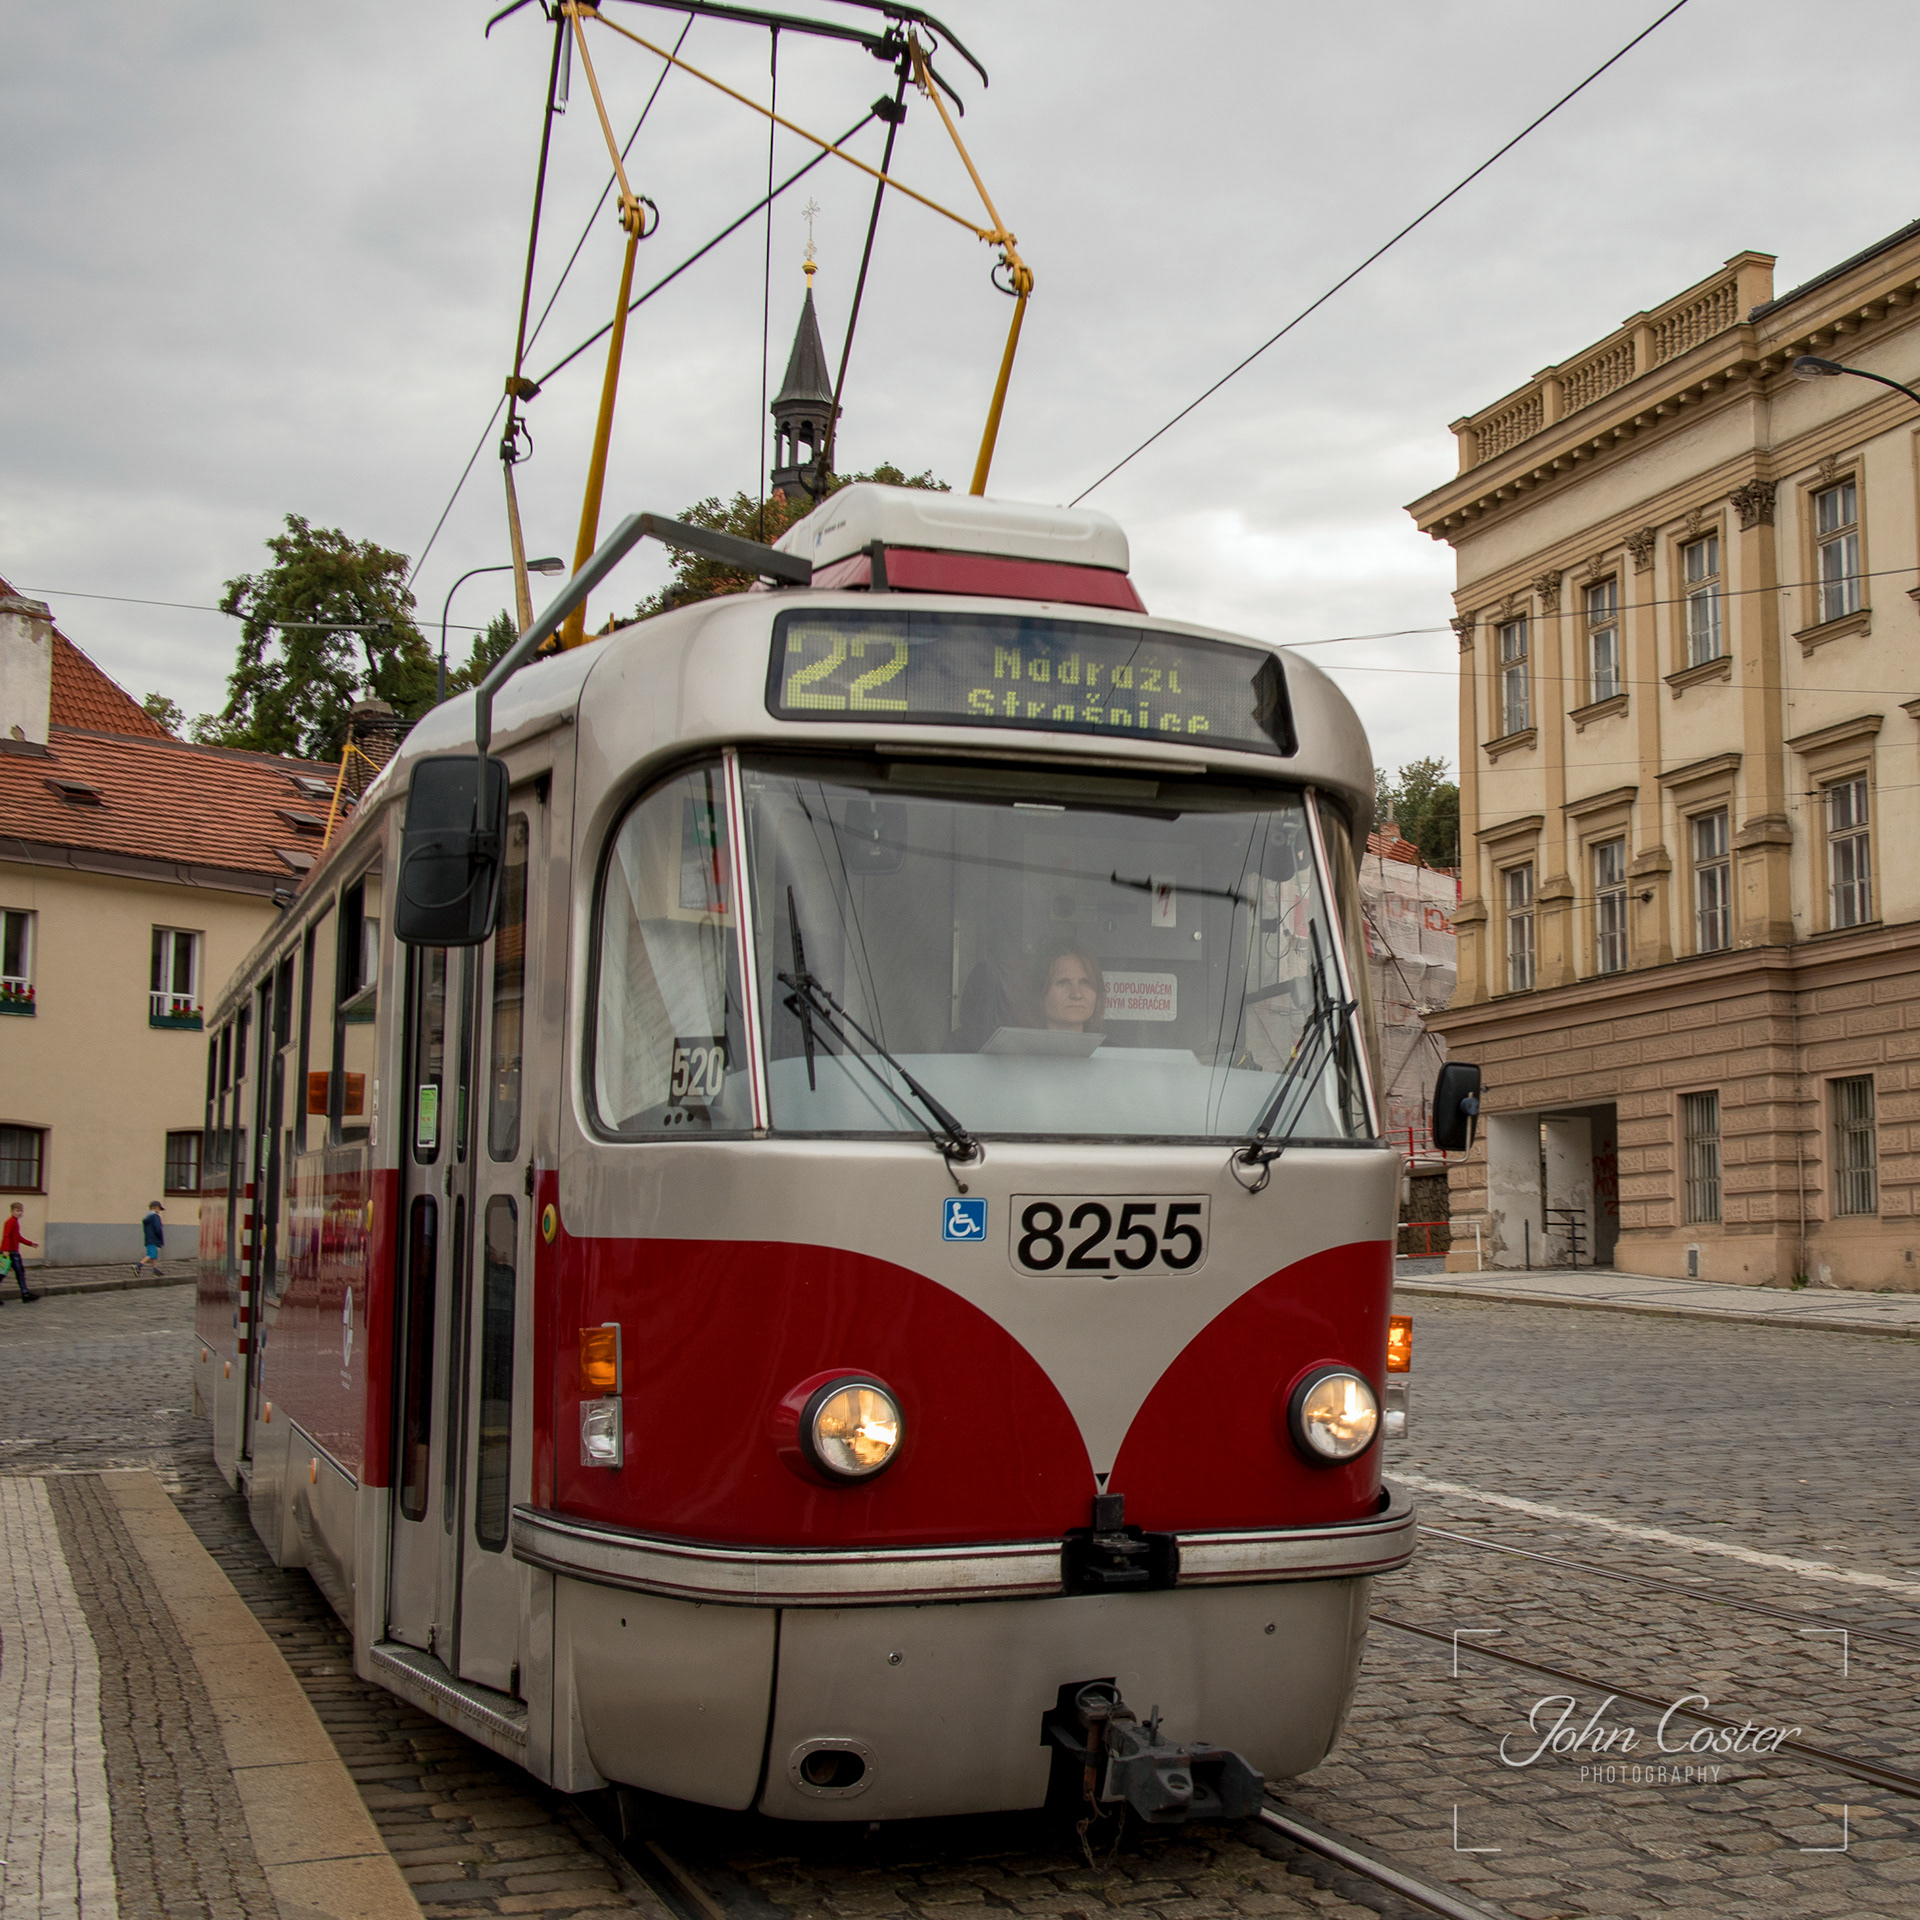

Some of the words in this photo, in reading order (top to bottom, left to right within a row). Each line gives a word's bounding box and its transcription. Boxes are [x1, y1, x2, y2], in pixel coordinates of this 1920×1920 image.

[786, 621, 909, 711] 22
[1104, 981, 1111, 994] S
[1113, 981, 1172, 995] ODPOJOVAČEM
[1127, 996, 1171, 1010] SBĚRAČEM
[671, 1046, 725, 1097] 520
[1017, 1201, 1203, 1271] 8255
